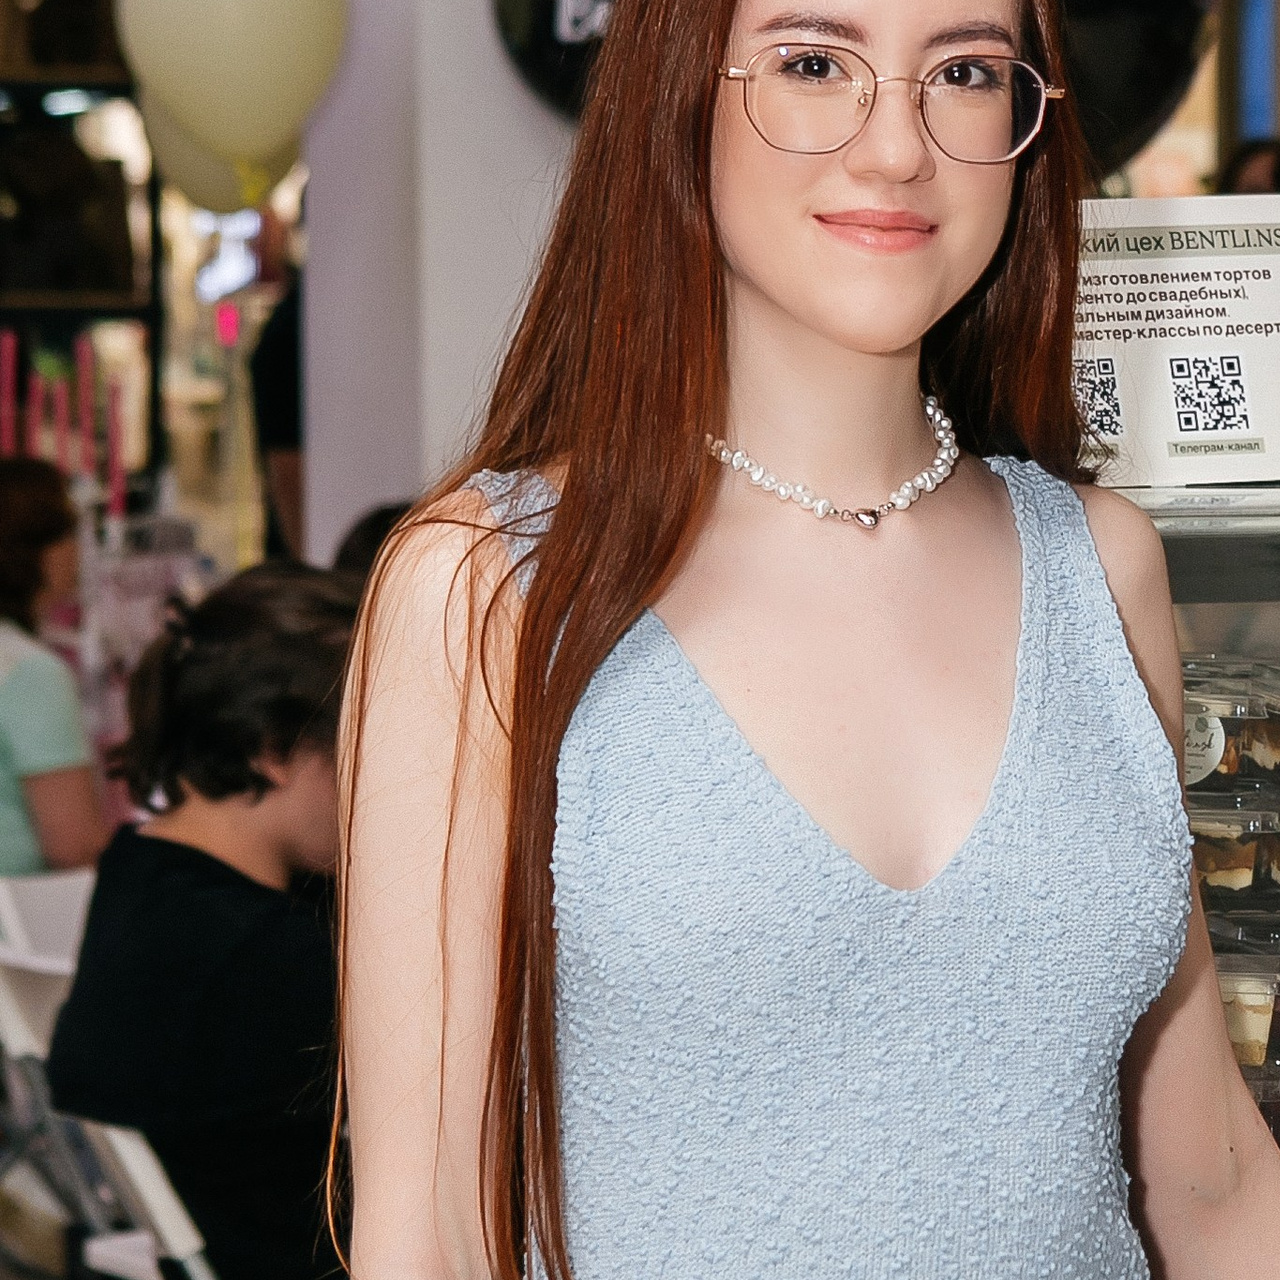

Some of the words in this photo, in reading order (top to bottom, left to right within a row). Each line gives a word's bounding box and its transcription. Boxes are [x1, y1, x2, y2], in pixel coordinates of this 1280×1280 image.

[1126, 236, 1165, 254] цех
[1083, 272, 1212, 286] изготовлением
[1215, 269, 1271, 284] тортов
[1126, 292, 1146, 305] до
[1203, 325, 1223, 337] по
[1172, 442, 1260, 454] Телеграм-канал
